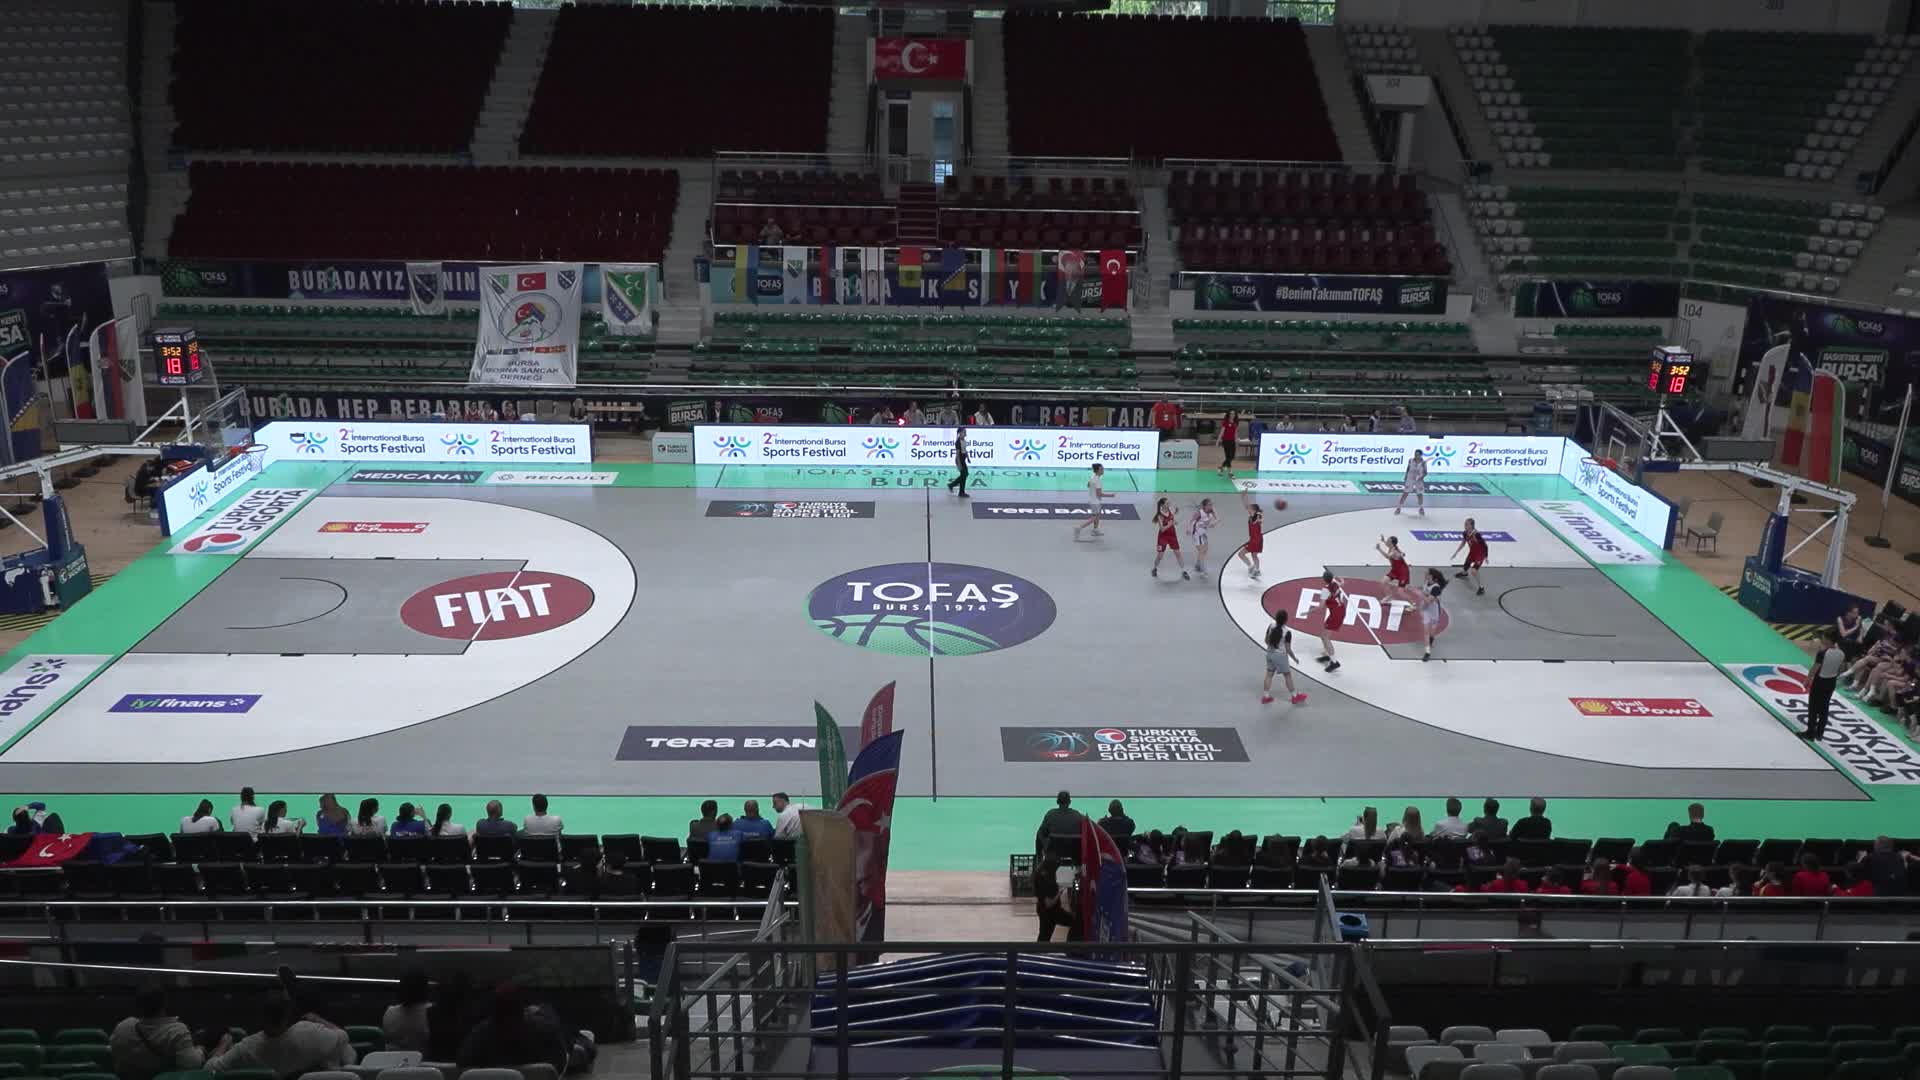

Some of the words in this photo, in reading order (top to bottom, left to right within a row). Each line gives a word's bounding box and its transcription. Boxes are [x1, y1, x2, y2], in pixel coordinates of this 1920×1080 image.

[289, 271, 404, 291] BURADAYIZ
[1684, 303, 1702, 317] 104
[162, 347, 181, 356] 3:52
[167, 358, 181, 374] 18
[1670, 366, 1690, 375] 3:52
[1669, 377, 1685, 393] 18
[240, 397, 326, 417] BURADA
[337, 399, 378, 418] HEP
[671, 409, 704, 423] BURSA
[351, 434, 401, 442] International
[402, 434, 424, 442] Bursa
[502, 435, 552, 443] International
[775, 438, 824, 446] International
[825, 438, 846, 446] Bursa
[923, 439, 971, 448] Internatial
[340, 443, 379, 455] Sports
[381, 443, 426, 454] Festival
[491, 444, 530, 456] Sports
[531, 444, 576, 455] Festival
[1069, 441, 1118, 449] International
[1119, 442, 1140, 450] Bursa
[1334, 446, 1382, 454] International
[1479, 447, 1527, 455] International
[762, 447, 800, 459] Sports
[802, 447, 847, 457] Festival
[911, 448, 948, 460] Sports
[950, 448, 994, 459] Ftival
[1057, 450, 1095, 462] Sports
[1096, 450, 1140, 461] Festival
[1321, 454, 1358, 466] Sports
[1360, 455, 1404, 465] Festival
[1465, 455, 1503, 468] Sports
[1504, 456, 1547, 466] Festival
[232, 461, 252, 481] Festiva
[353, 472, 462, 480] MEDICANA
[872, 478, 988, 488] BURA
[1365, 483, 1472, 491] MEDANA
[206, 489, 281, 531] TÜRKİYE
[237, 489, 308, 531] SİGORTA
[847, 582, 1019, 608] TOFAŞ
[434, 583, 551, 628] FIAT
[944, 604, 987, 612] 1974
[1295, 588, 1412, 632] FAT
[1616, 706, 1701, 715] V-Power
[743, 738, 816, 748] BAN
[1097, 744, 1222, 752] BASKETBOL
